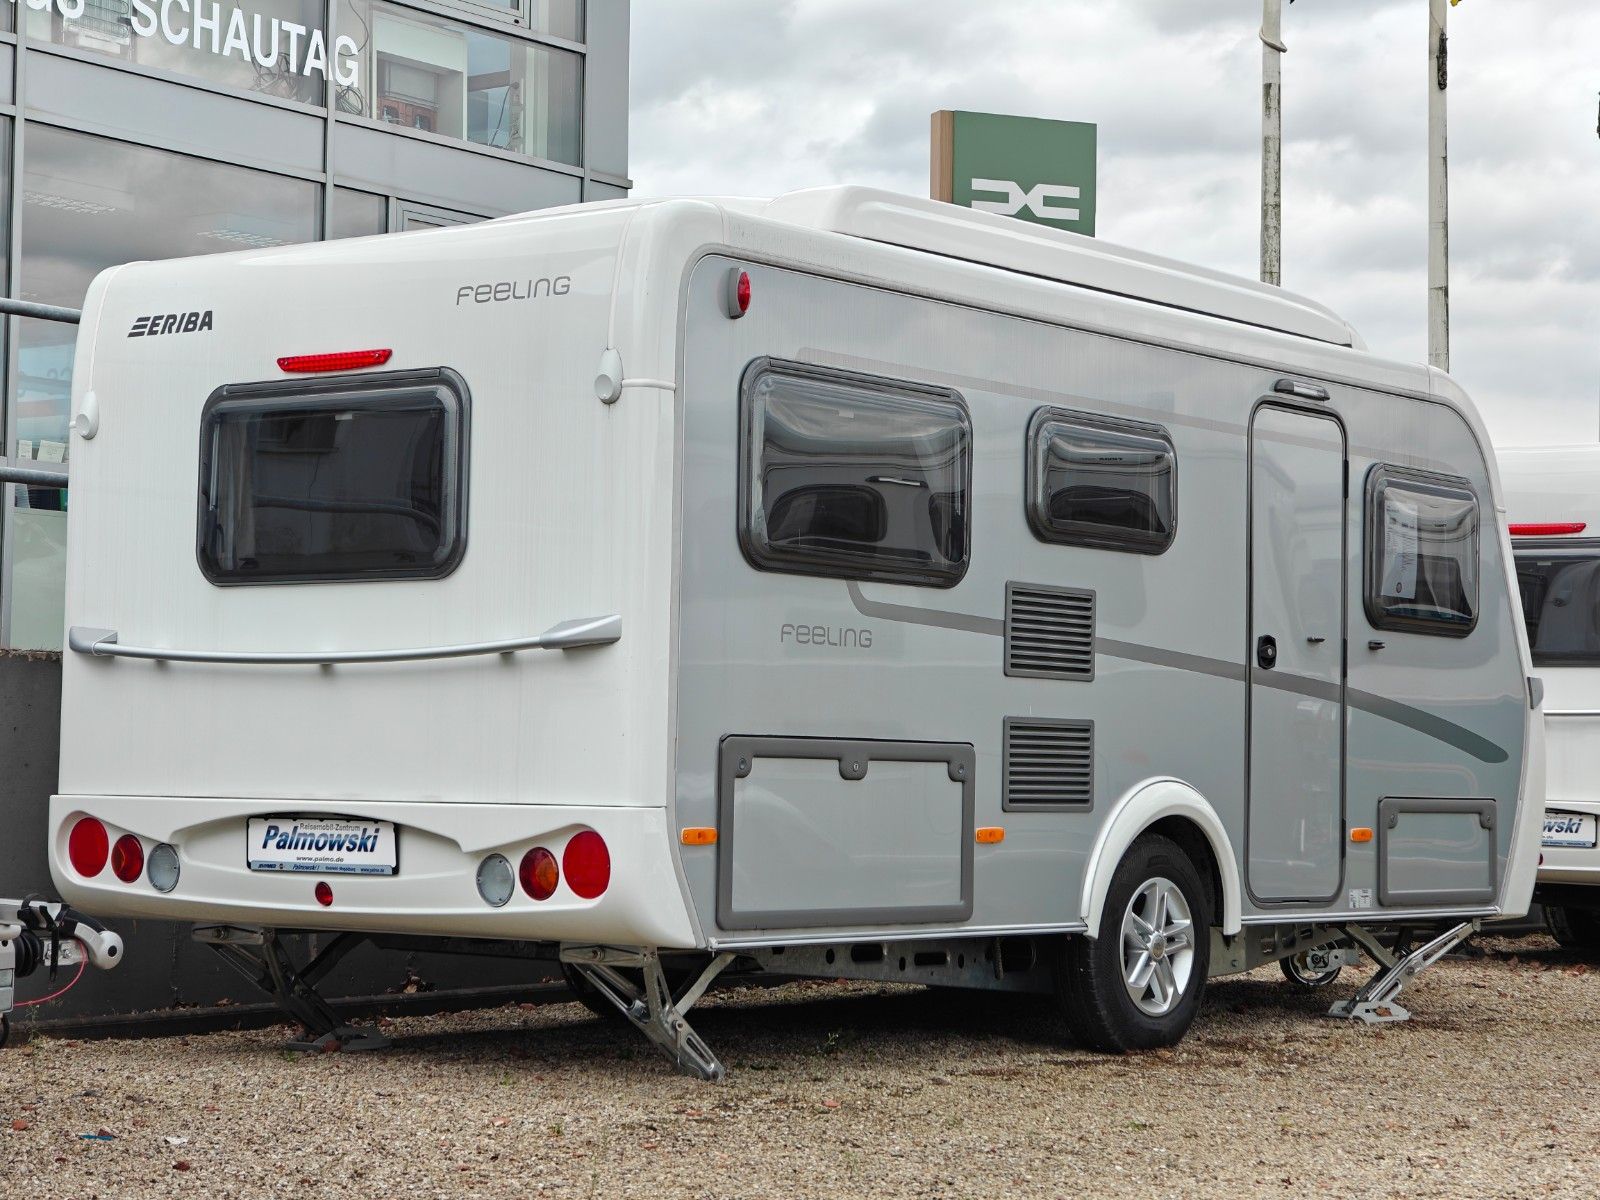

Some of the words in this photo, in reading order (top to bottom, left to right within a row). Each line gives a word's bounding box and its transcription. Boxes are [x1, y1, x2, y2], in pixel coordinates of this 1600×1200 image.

[130, 0, 360, 88] SCHAUTAG
[128, 310, 214, 338] ERIBA
[262, 825, 380, 853] Palmowski
